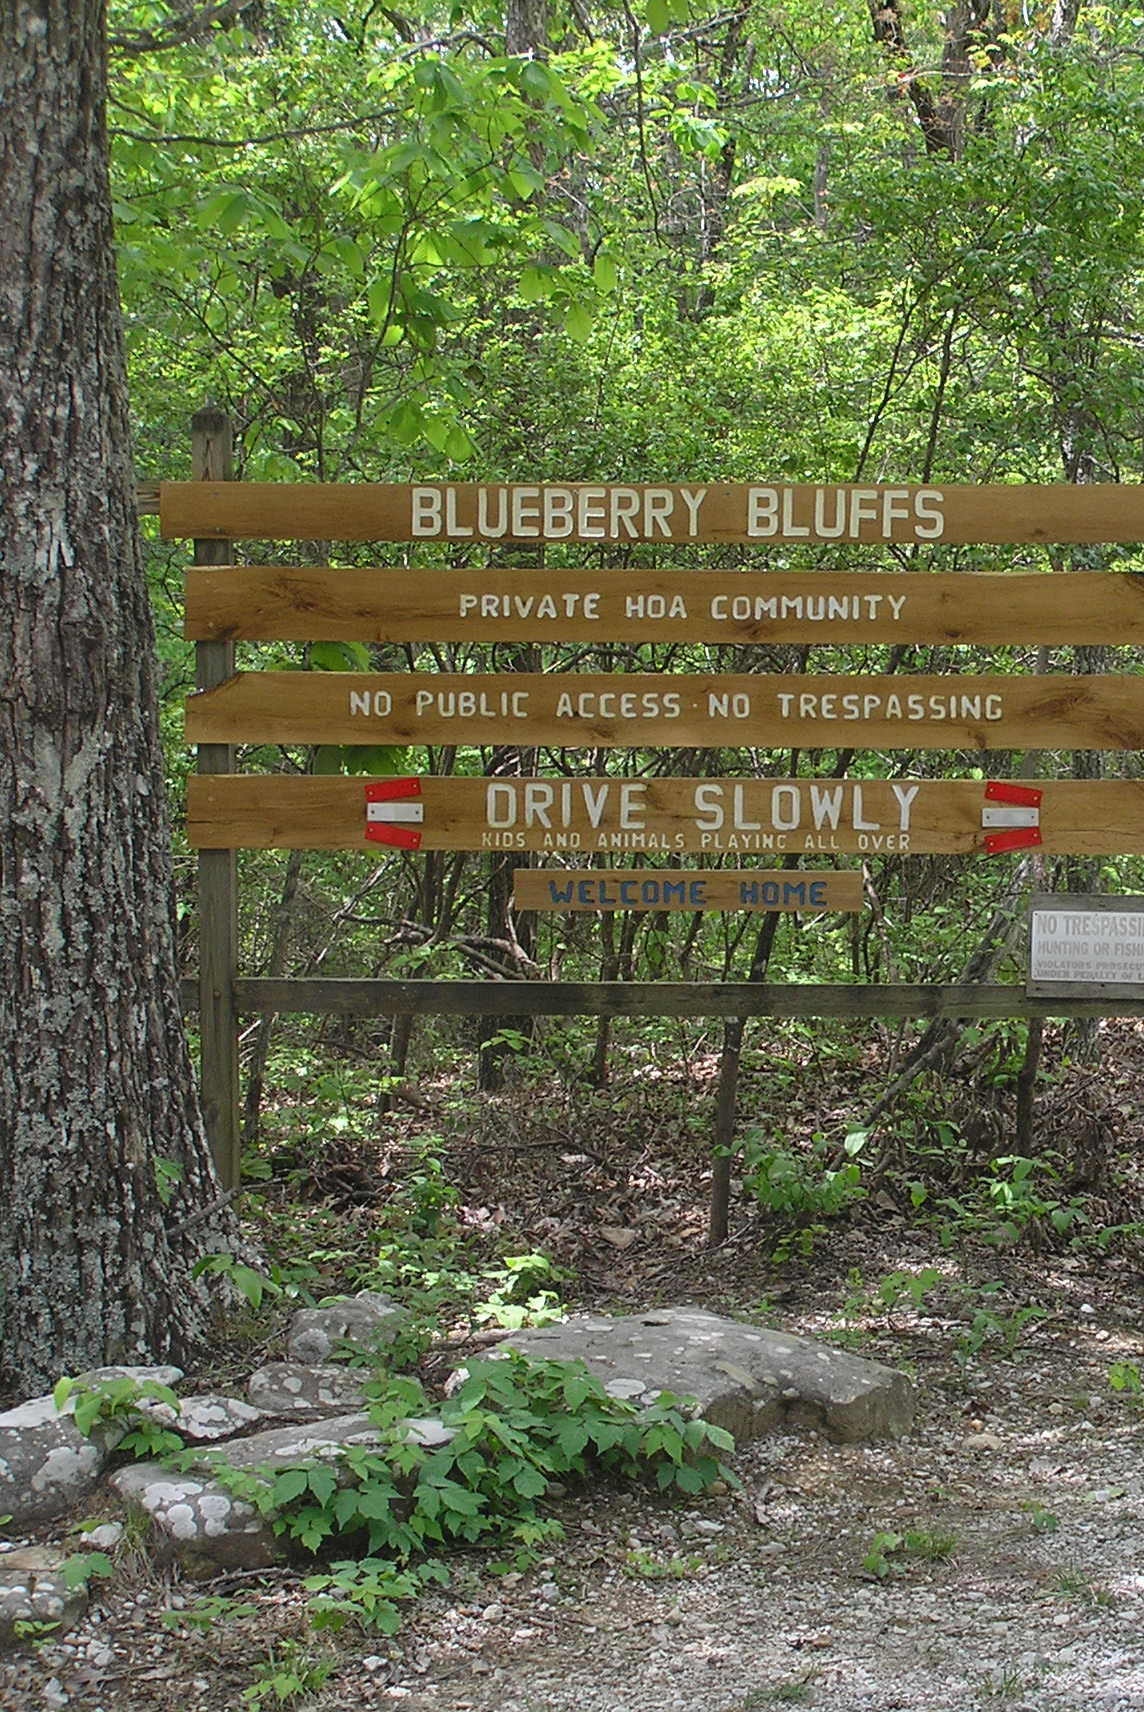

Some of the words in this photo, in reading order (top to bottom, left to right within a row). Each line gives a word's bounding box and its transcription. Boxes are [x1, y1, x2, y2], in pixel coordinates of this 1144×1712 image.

[411, 487, 707, 538] BLUEBERRY
[747, 487, 945, 539] BLUFFS
[459, 593, 600, 619] PRIVATE
[625, 594, 687, 619] HOA
[711, 595, 906, 620] COMMUNITY
[350, 690, 392, 717] NO
[415, 690, 529, 717] PUBLIC
[556, 692, 680, 718] ACCESS
[708, 693, 750, 719] NO
[776, 693, 1002, 720] TRESPASSING
[487, 783, 648, 829] DRIVE
[695, 784, 920, 831] SLOWLY
[481, 831, 526, 848] KIDS
[543, 832, 581, 848] AND
[598, 833, 685, 849] ANIMALS
[804, 834, 840, 849] ALL
[858, 834, 911, 850] OVER
[549, 880, 707, 905] WELCOME
[739, 881, 828, 906] HOME
[1038, 915, 1057, 935] NO
[1038, 940, 1089, 956] HUNTING
[1094, 942, 1110, 956] OR
